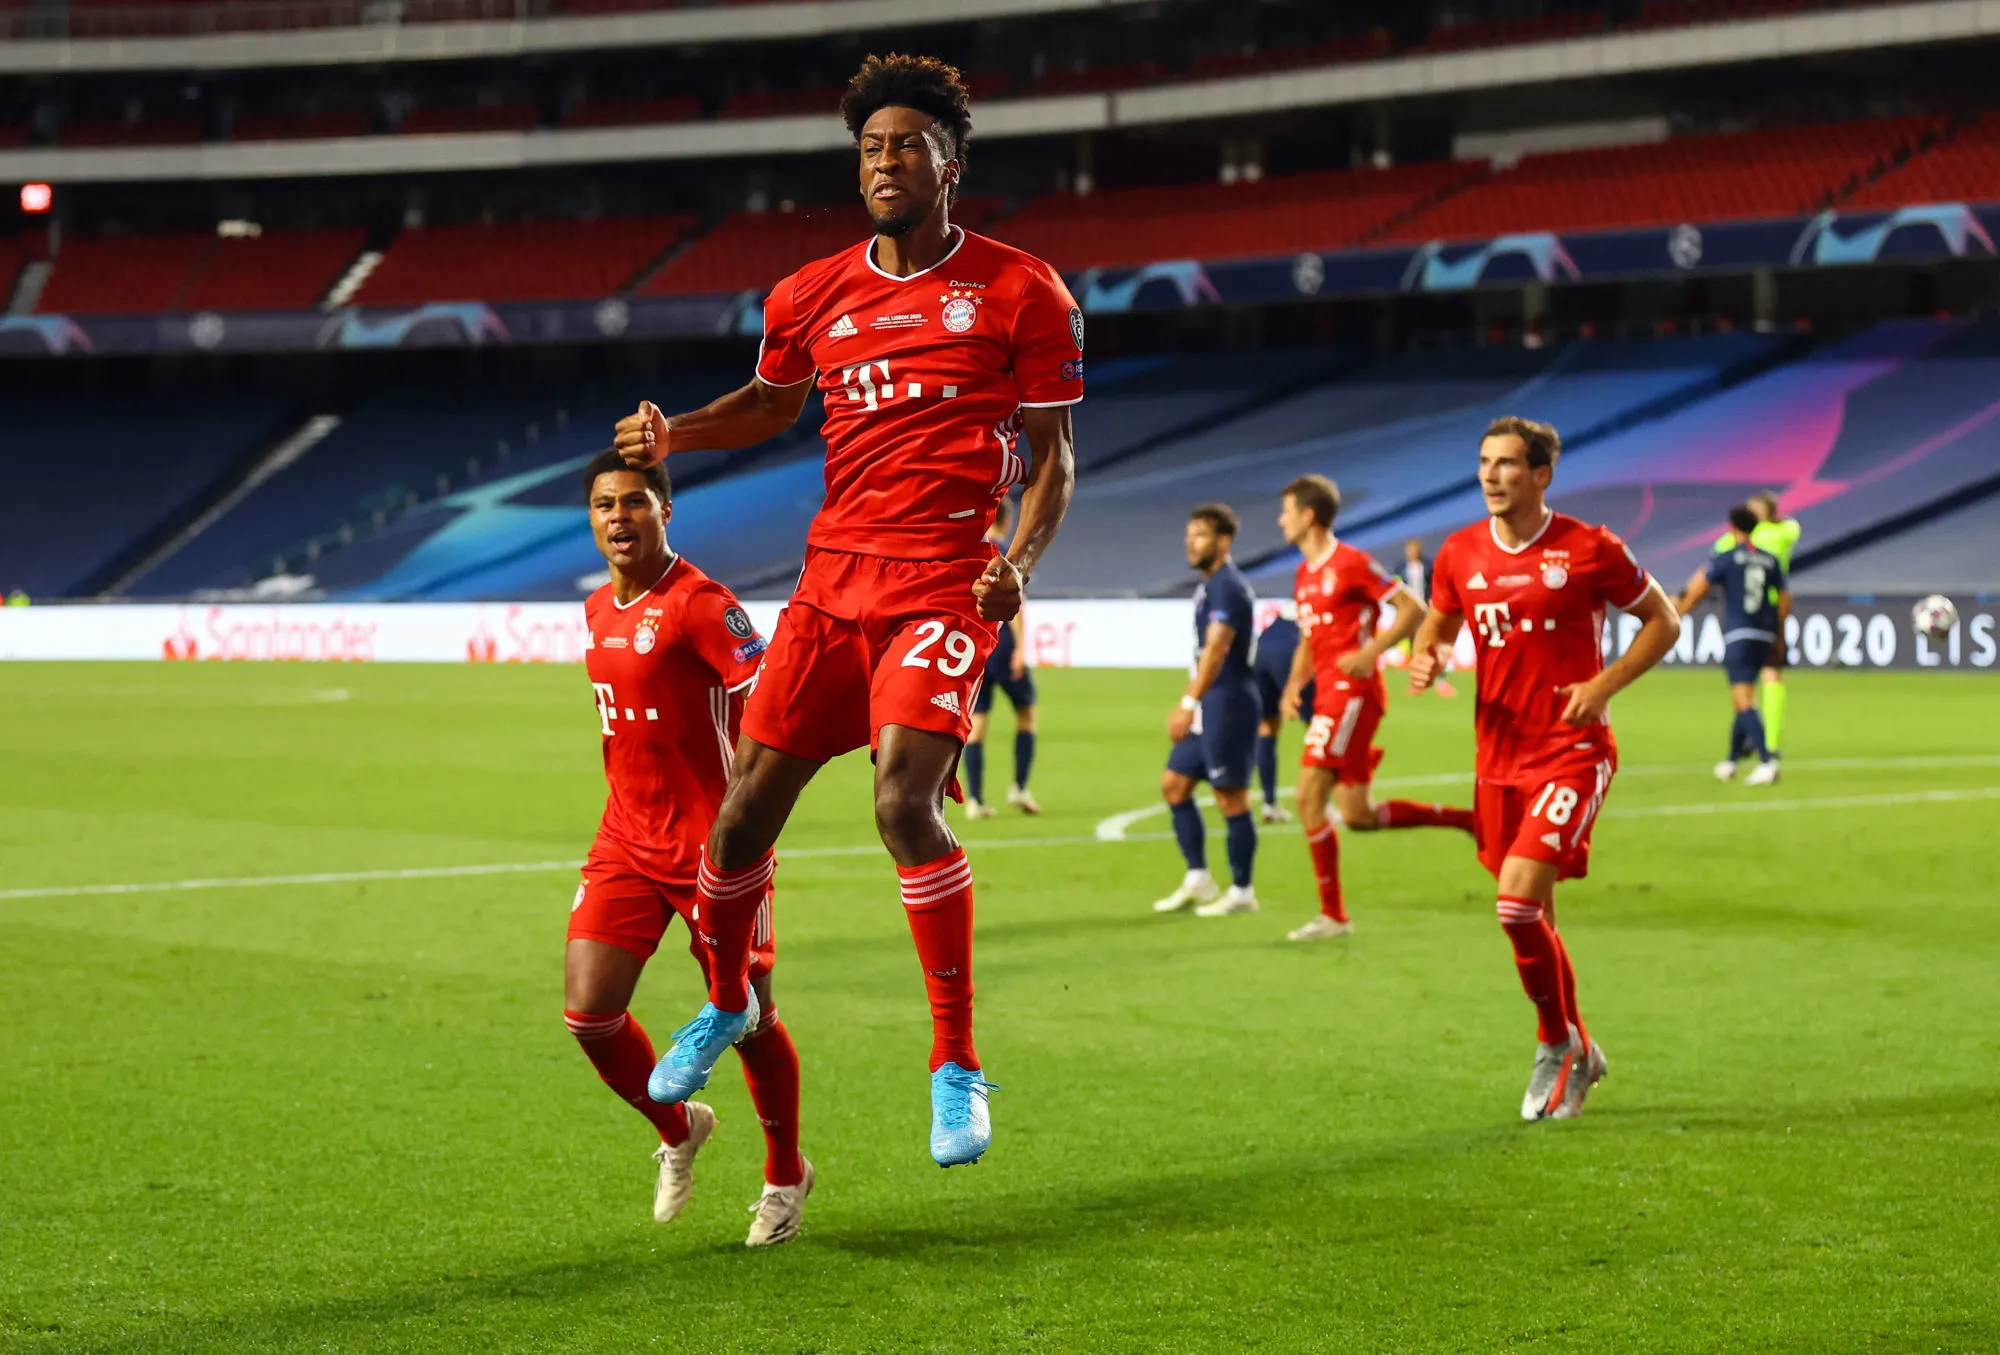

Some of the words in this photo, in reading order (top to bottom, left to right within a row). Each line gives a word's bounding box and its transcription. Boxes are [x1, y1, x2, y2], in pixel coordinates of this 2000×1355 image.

[949, 280, 986, 289] Danke
[828, 328, 859, 338] adidas
[206, 605, 377, 662] Santander
[736, 621, 746, 631] 5
[901, 620, 976, 677] 29
[930, 697, 962, 716] adidas
[1531, 782, 1578, 826] 18
